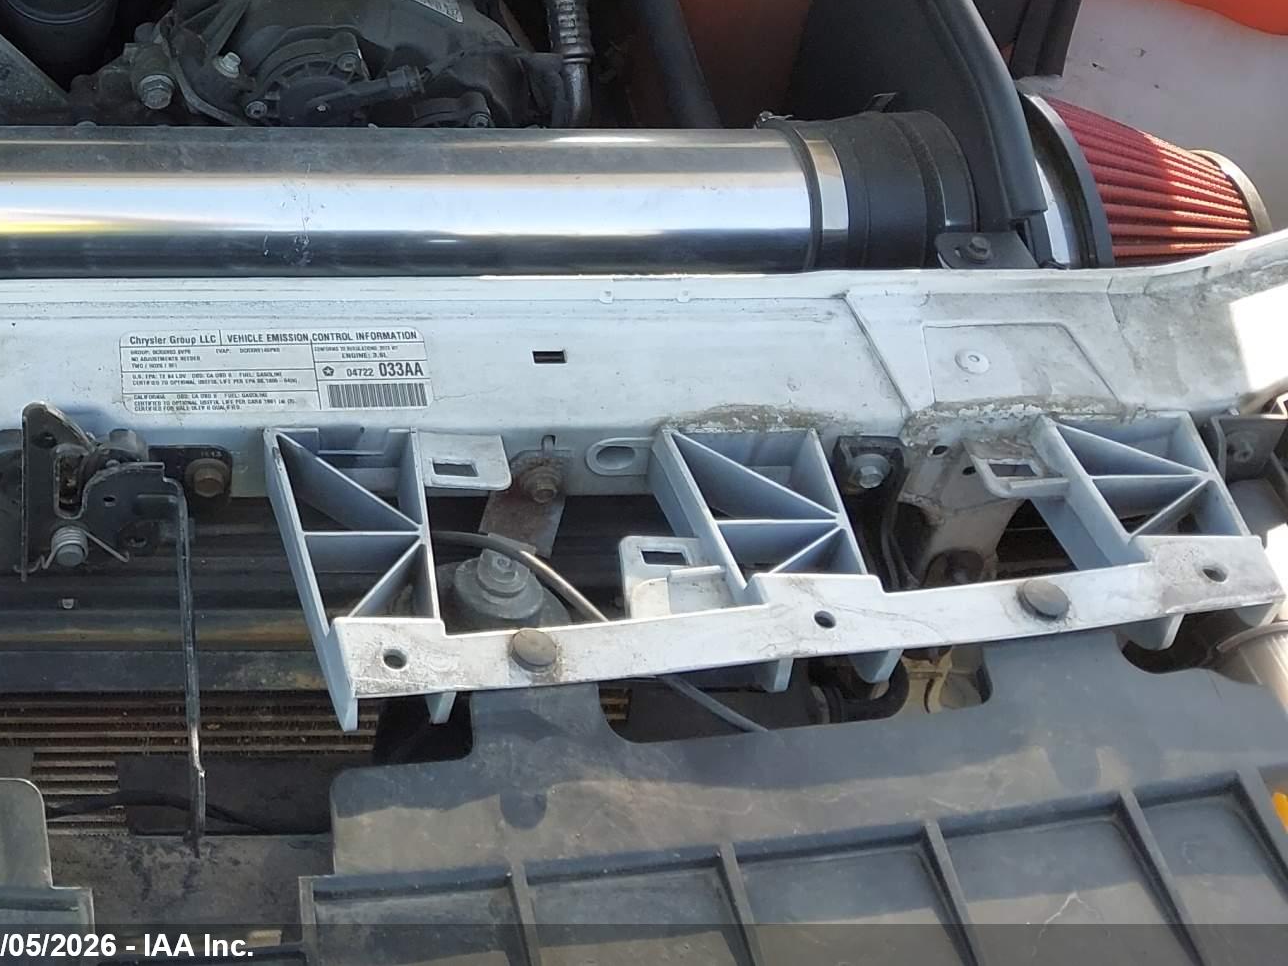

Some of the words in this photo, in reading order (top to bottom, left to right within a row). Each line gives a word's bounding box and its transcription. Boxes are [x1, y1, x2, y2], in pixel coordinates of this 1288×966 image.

[129, 335, 166, 347] Chrysler
[169, 335, 196, 346] Group
[199, 334, 217, 344] LLC
[226, 333, 264, 343] VEHICLE
[266, 332, 309, 342] EMISSION
[312, 332, 353, 341] CONTROL
[355, 331, 417, 340] INFORMATION
[346, 368, 375, 377] 04722
[378, 362, 424, 377] 033AA
